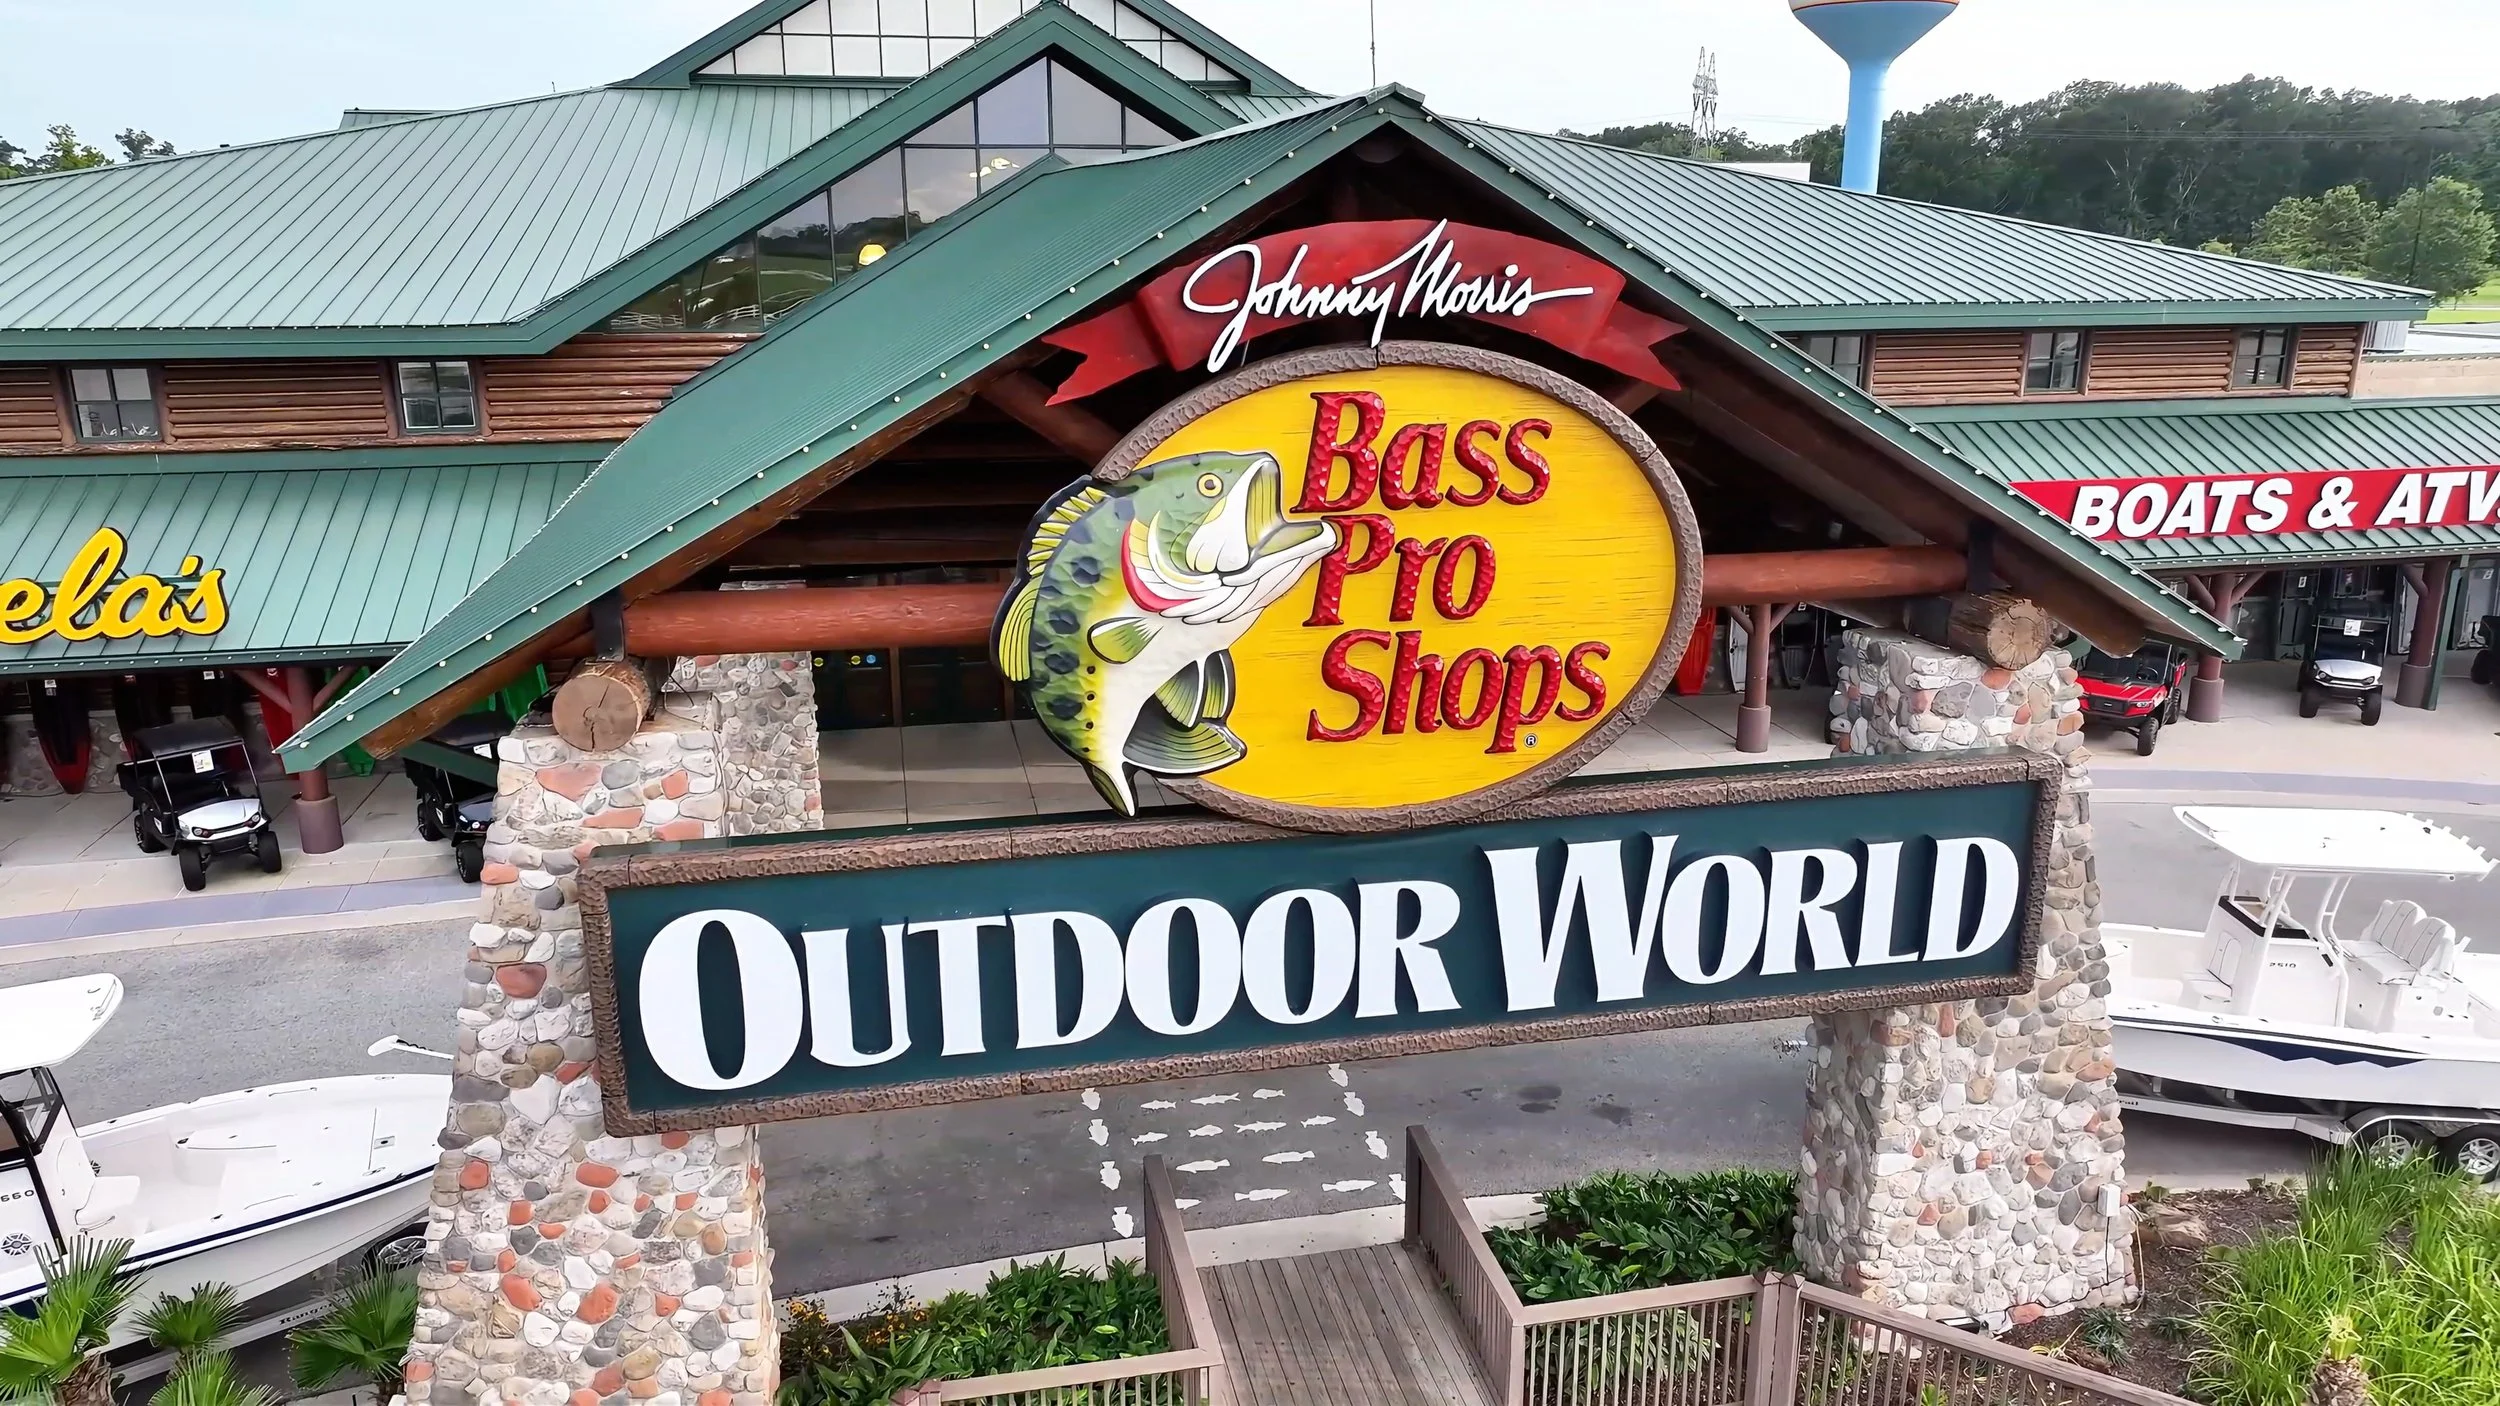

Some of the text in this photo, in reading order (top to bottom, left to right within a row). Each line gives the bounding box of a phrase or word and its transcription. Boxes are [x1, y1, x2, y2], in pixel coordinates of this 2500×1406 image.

[1183, 218, 1594, 372] Johnny Morris
[1290, 391, 1553, 513] Bass
[2070, 471, 2500, 539] BOATS & ATV
[1302, 514, 1496, 627] Pro
[1306, 628, 1611, 754] Shops
[639, 834, 2020, 1090] OUTDOOR WORLD
